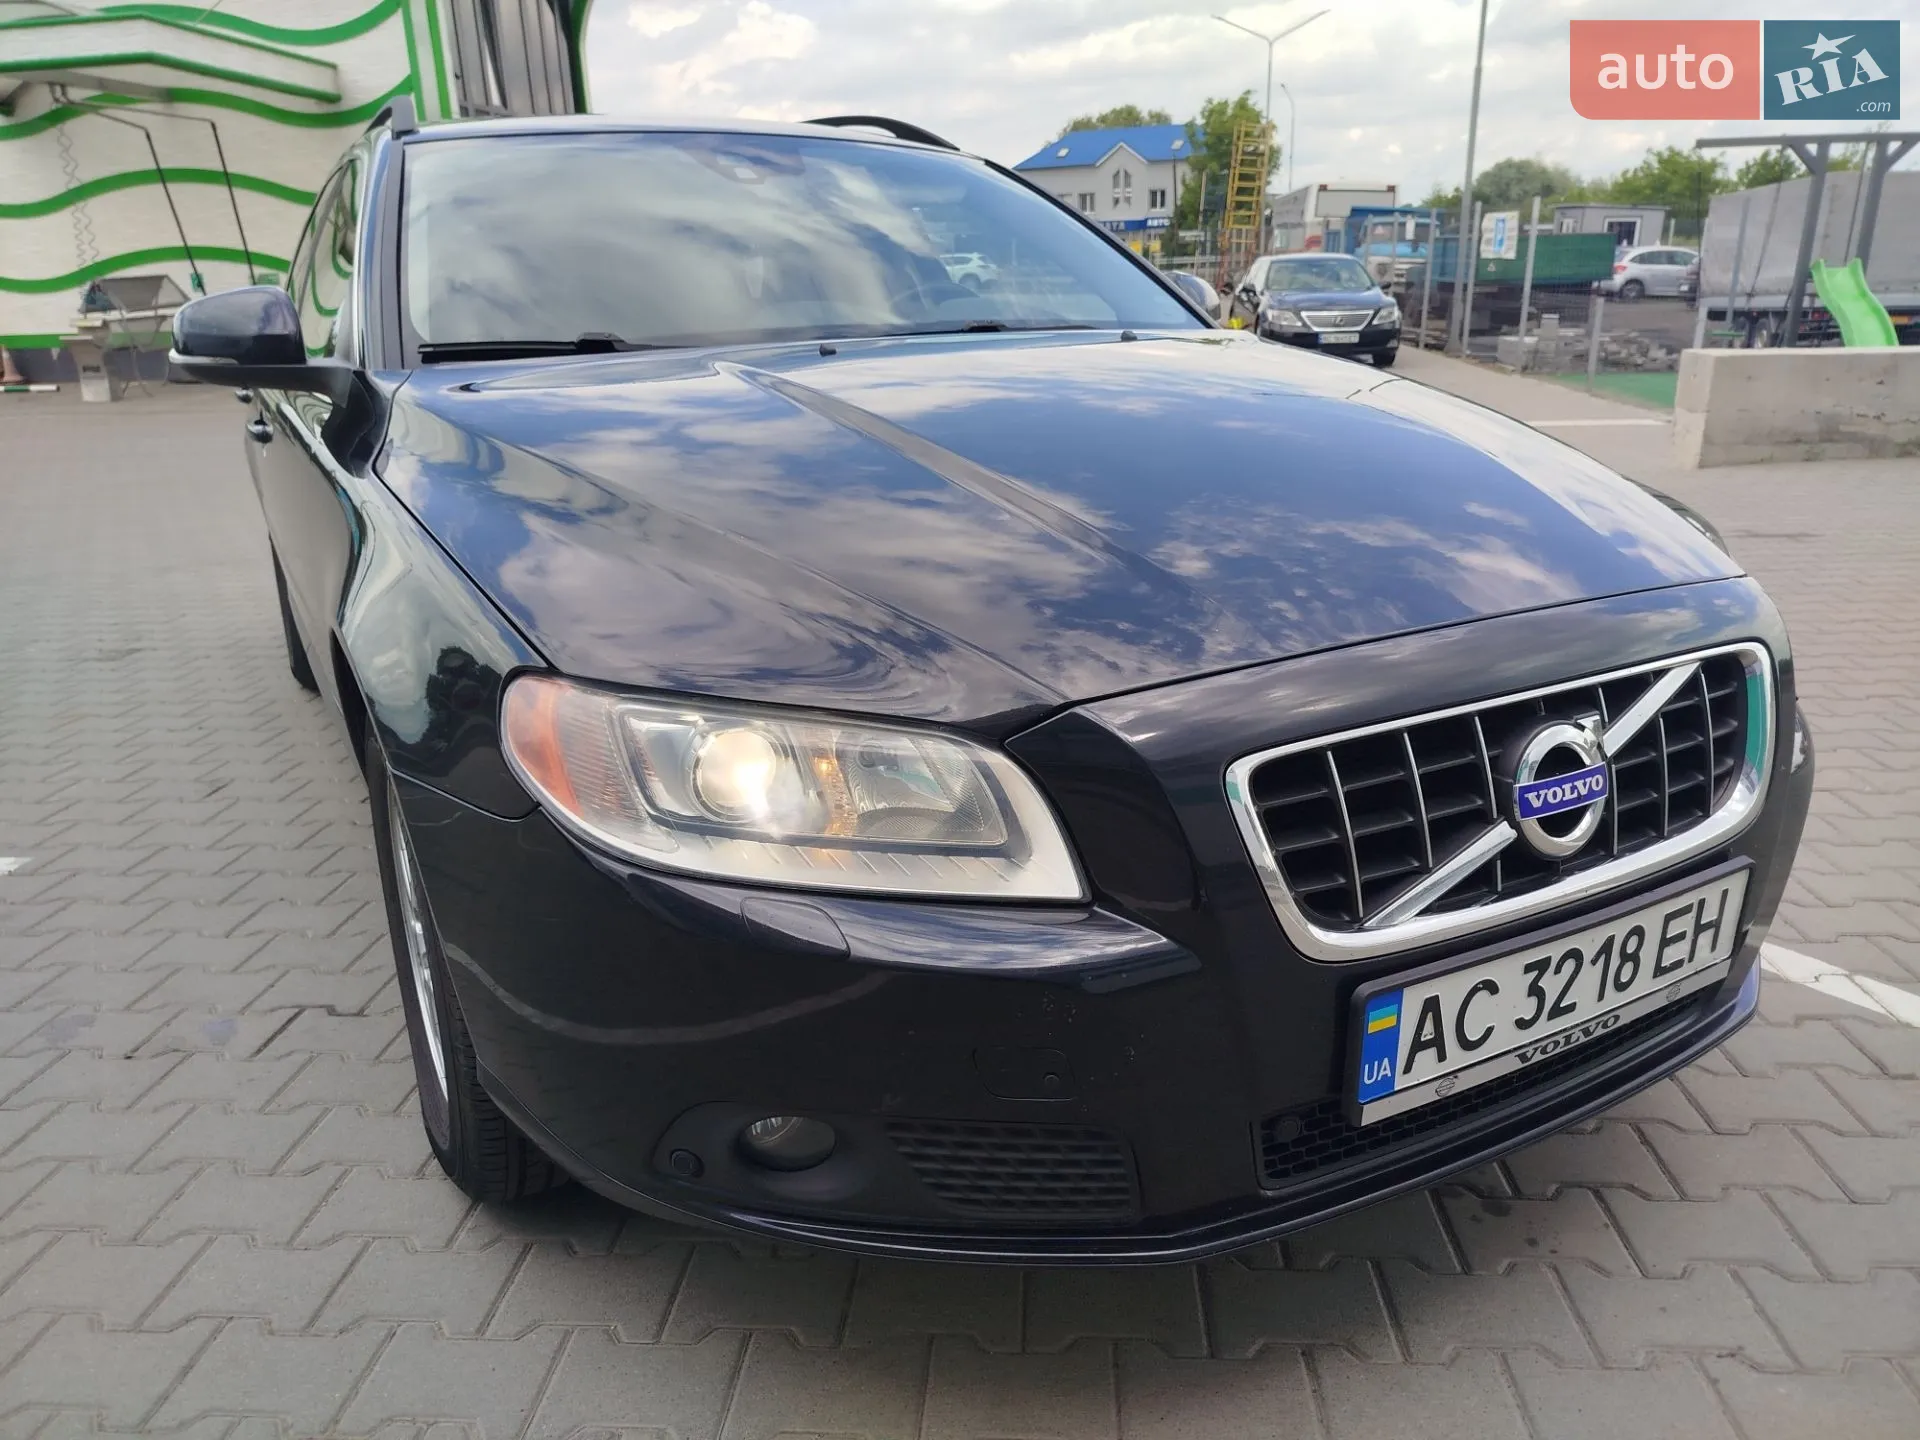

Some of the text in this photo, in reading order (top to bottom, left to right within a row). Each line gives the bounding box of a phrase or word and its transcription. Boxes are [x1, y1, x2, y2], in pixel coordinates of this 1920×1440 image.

[1524, 774, 1604, 809] VOLVO
[1402, 887, 1729, 1075] AC 3218 EH
[1514, 1014, 1621, 1064] VOLVO
[1363, 1057, 1392, 1085] UA
